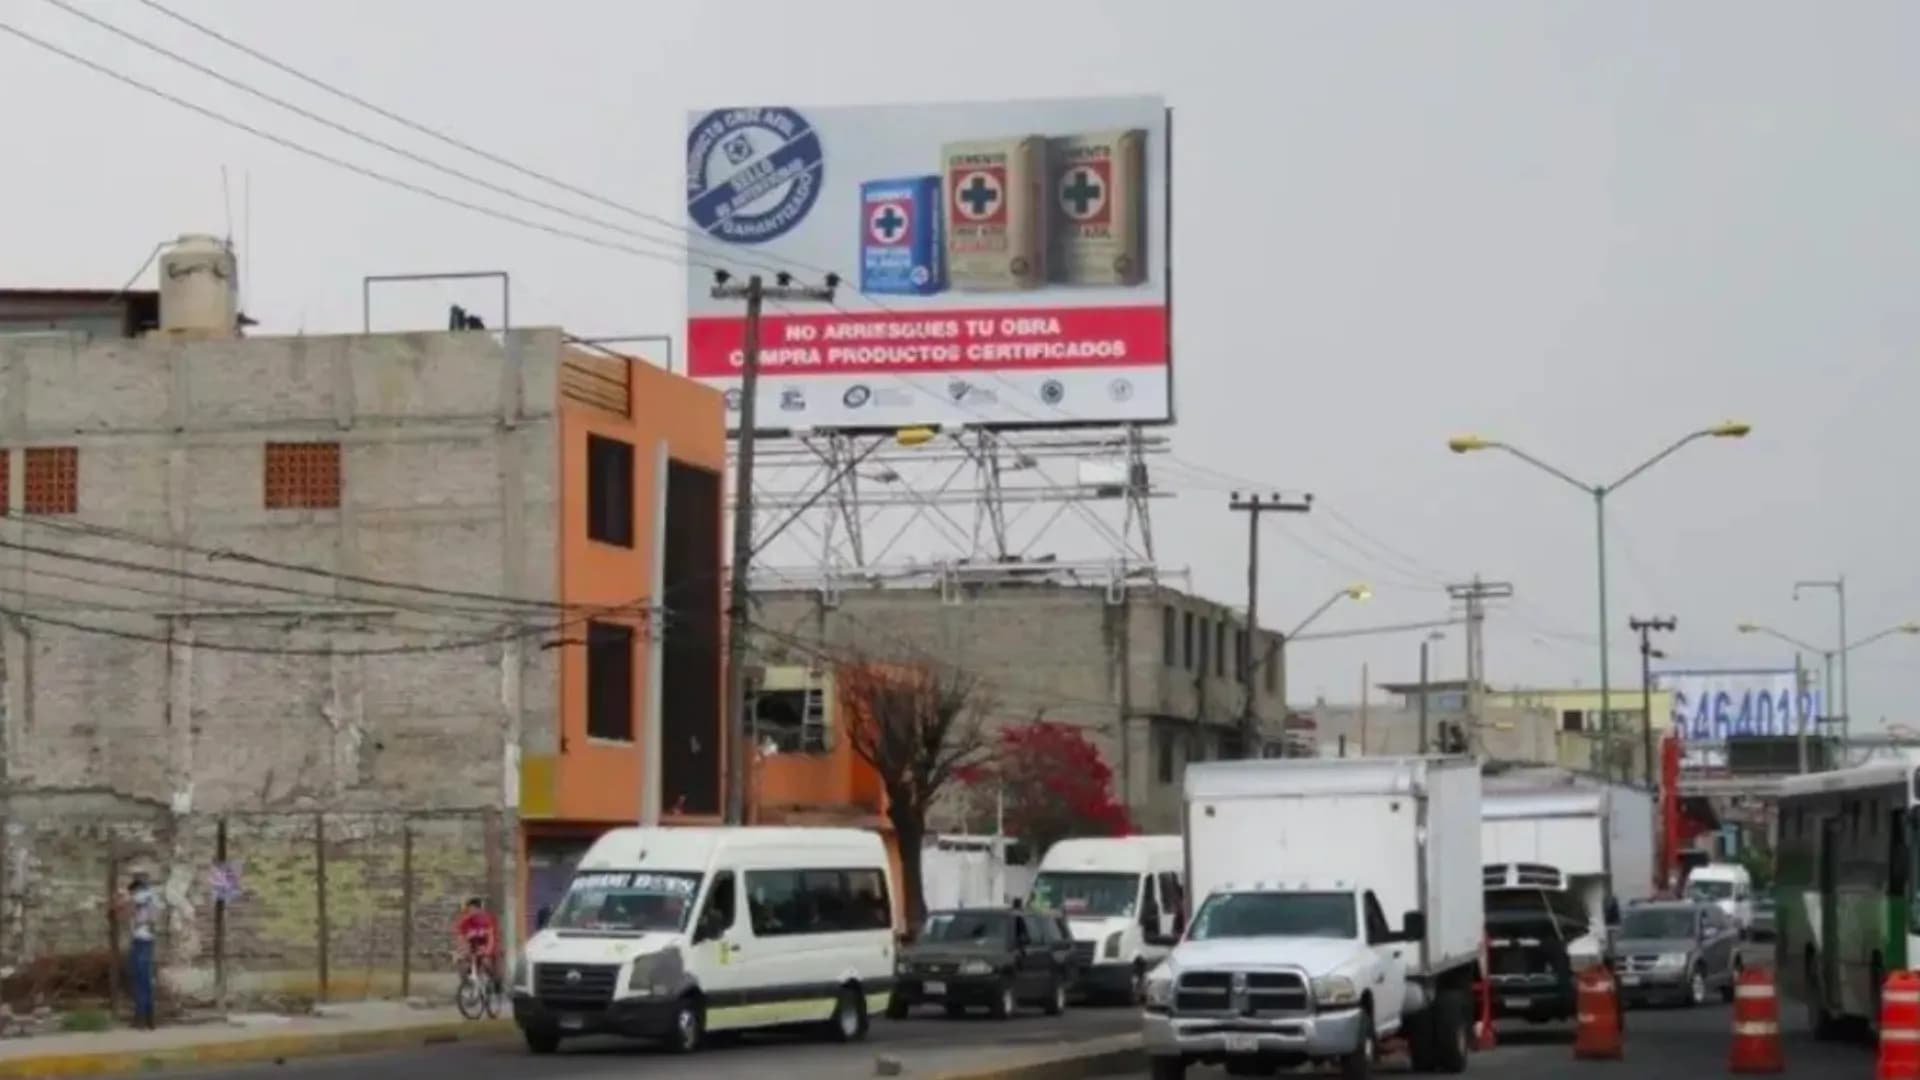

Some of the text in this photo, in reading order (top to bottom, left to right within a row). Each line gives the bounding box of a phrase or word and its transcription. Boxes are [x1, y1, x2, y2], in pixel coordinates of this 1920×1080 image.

[785, 316, 1061, 341] NO ARRIESGUES TU OBRA
[728, 339, 1127, 369] CMPRA PRODUCTOS CERTIFICADOS
